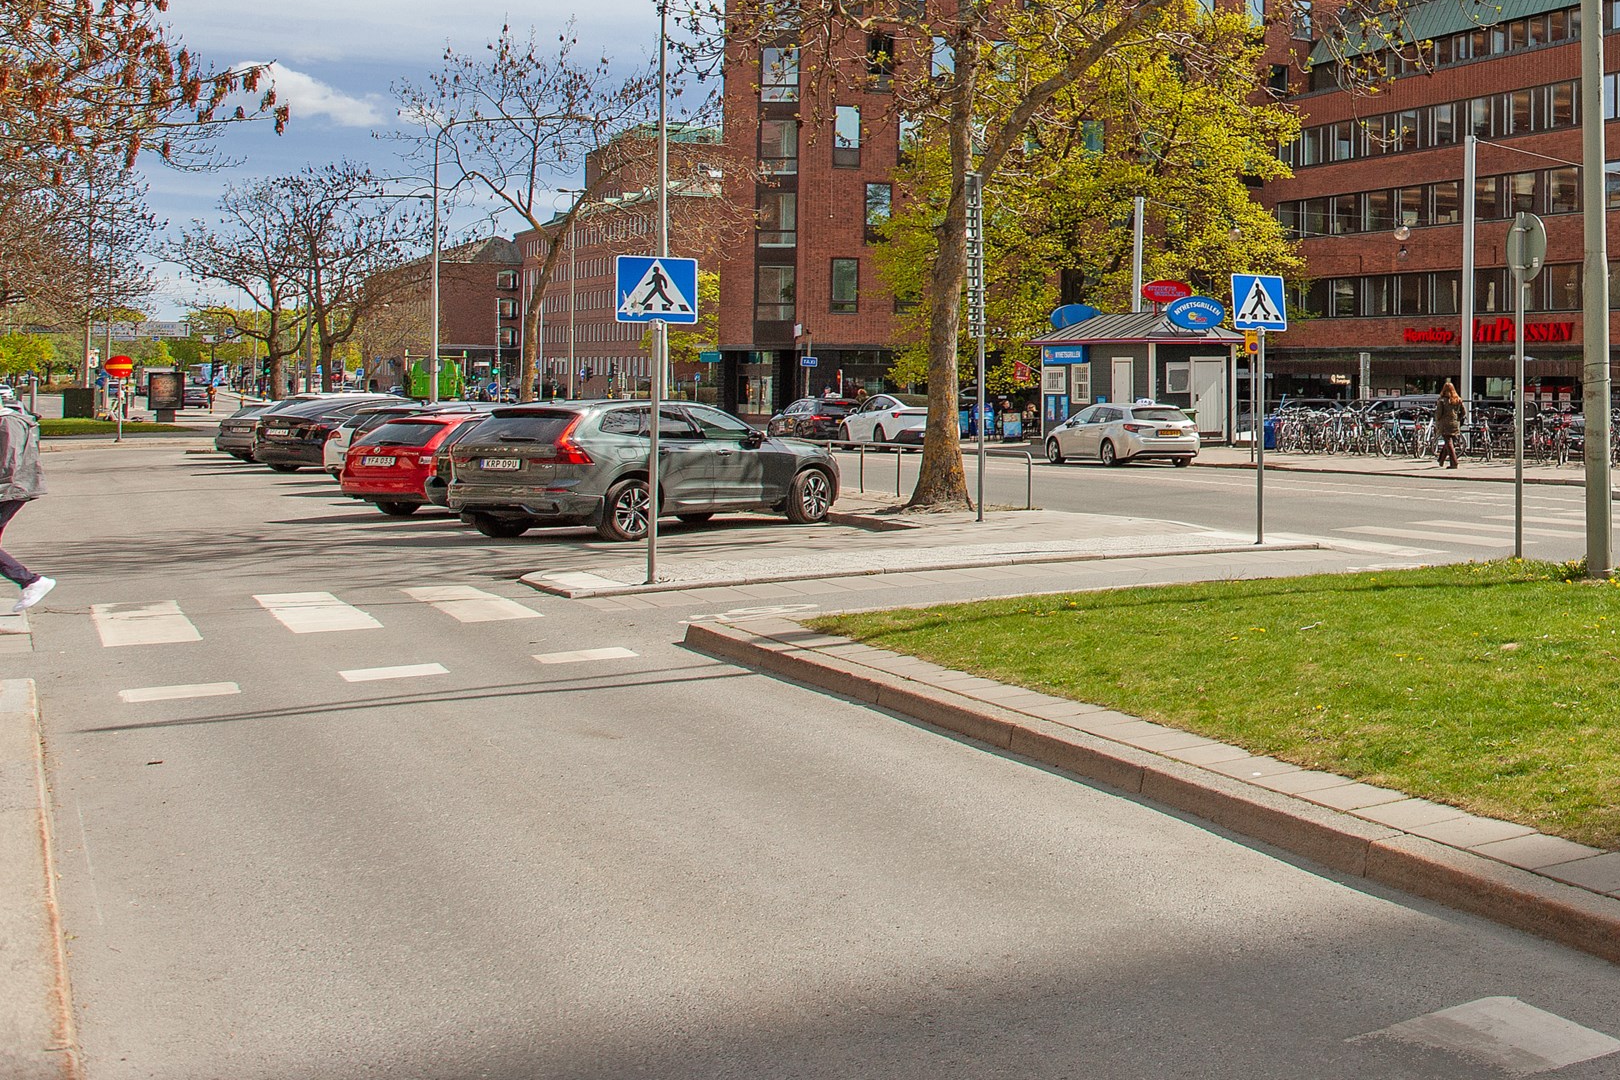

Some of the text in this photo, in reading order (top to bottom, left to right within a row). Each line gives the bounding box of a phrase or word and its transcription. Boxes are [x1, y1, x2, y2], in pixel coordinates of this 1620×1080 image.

[1173, 301, 1222, 317] NYHETSGRILLEN
[1403, 328, 1454, 344] Hemköp
[486, 460, 517, 468] KRP 09U
